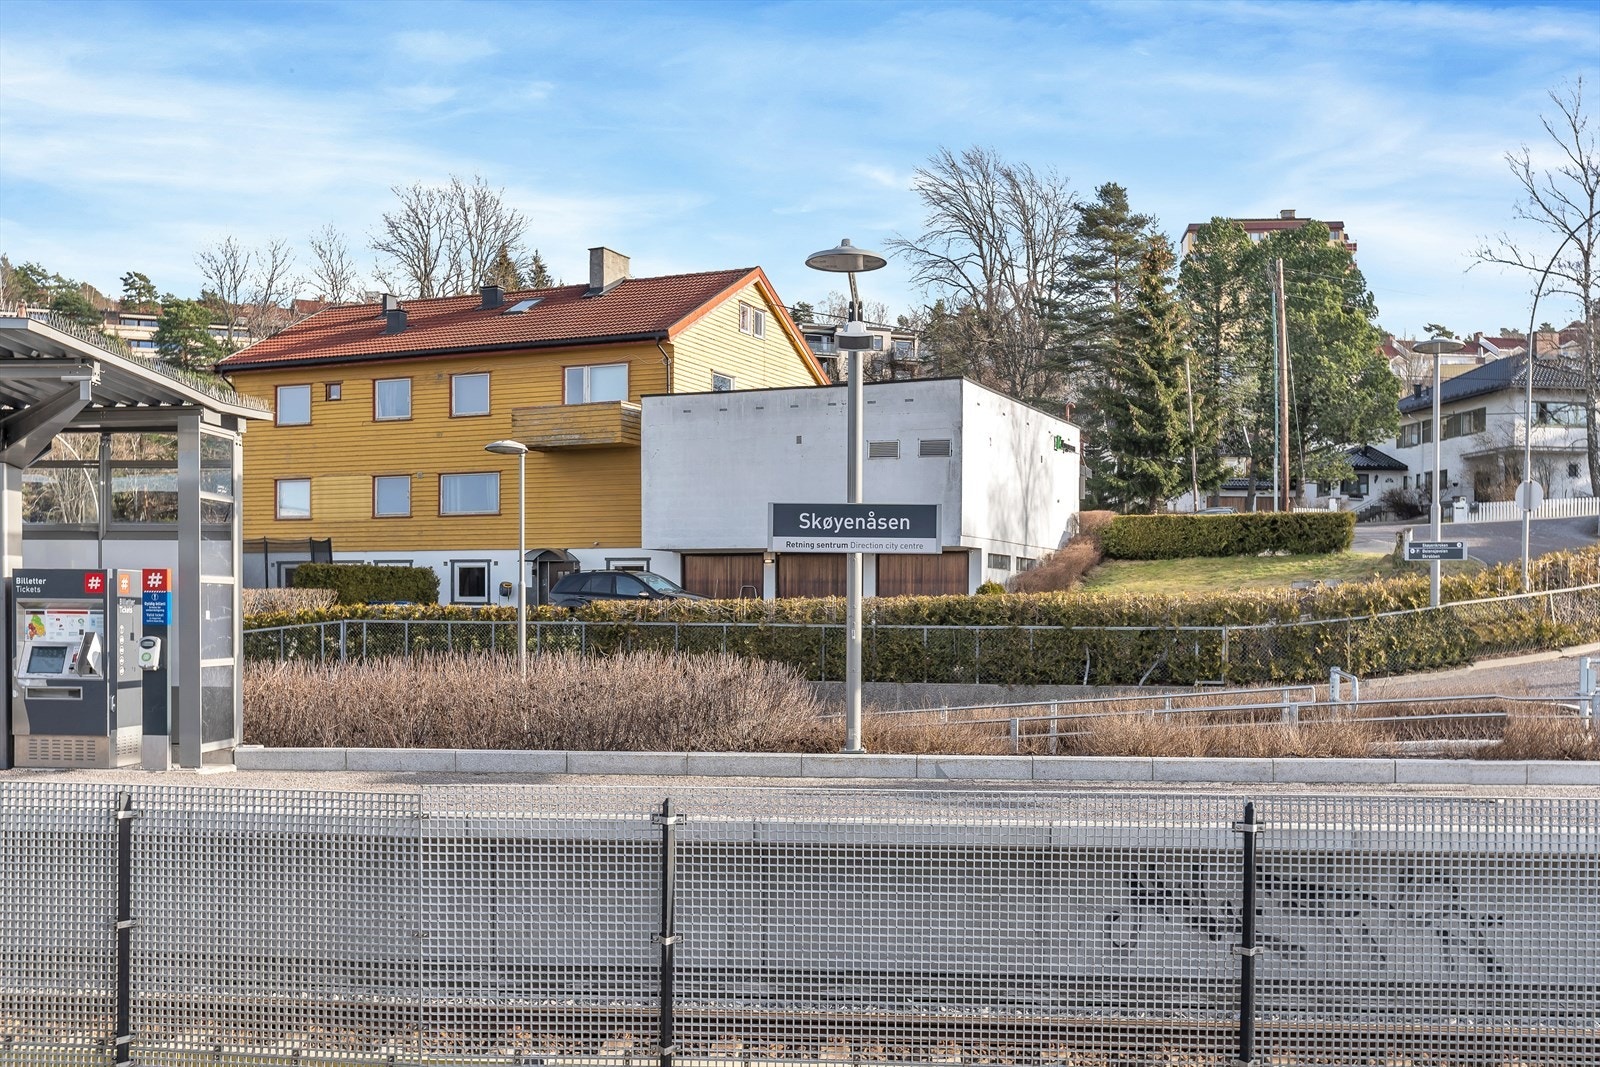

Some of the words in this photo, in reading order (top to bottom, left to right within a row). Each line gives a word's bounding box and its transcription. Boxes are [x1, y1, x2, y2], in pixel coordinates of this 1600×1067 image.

[799, 511, 910, 533] Skøyenåsen
[786, 541, 815, 549] Retning
[816, 541, 849, 549] sentrum
[850, 541, 884, 549] Direction
[885, 542, 899, 550] city
[15, 577, 47, 585] Billetter
[15, 585, 41, 593] Tickets
